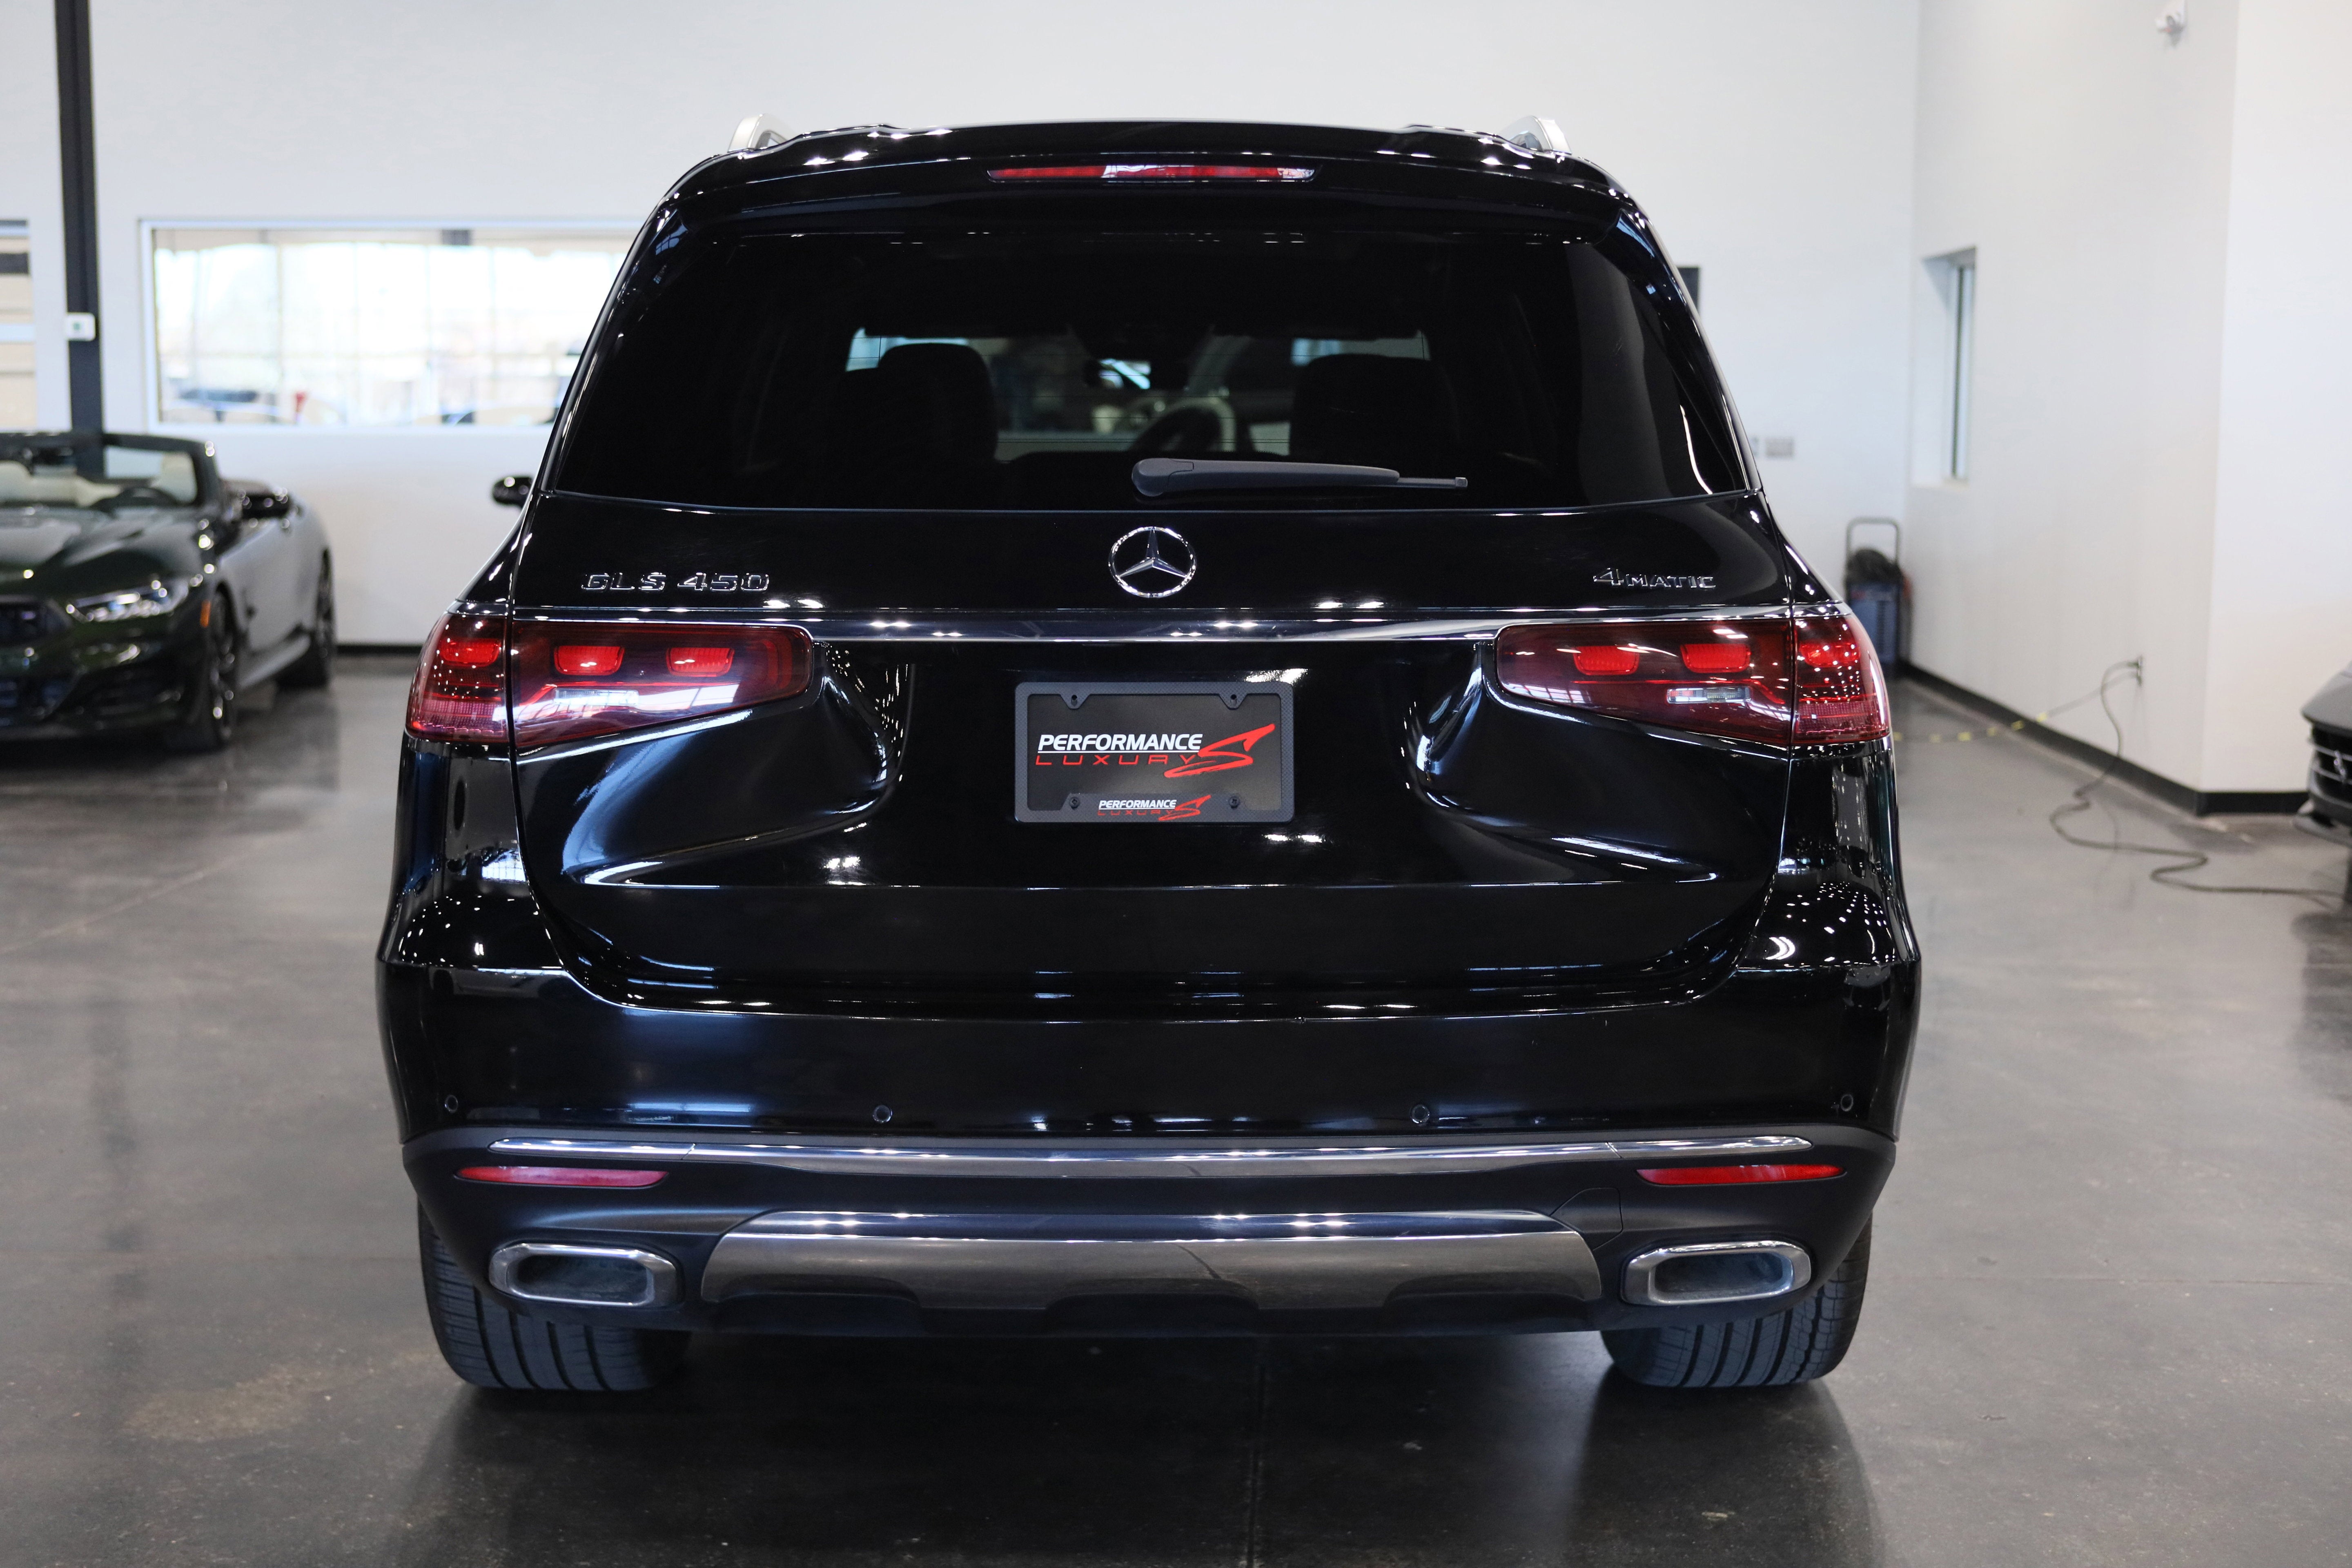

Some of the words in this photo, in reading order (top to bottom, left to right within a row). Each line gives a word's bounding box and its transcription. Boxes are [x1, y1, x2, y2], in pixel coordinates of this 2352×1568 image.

[677, 572, 769, 591] 450
[1593, 568, 1716, 588] 4MATIC
[1038, 734, 1203, 751] PERFORMANCE
[1036, 755, 1195, 765] LUXURY
[1098, 800, 1177, 808] PERFORMANCE
